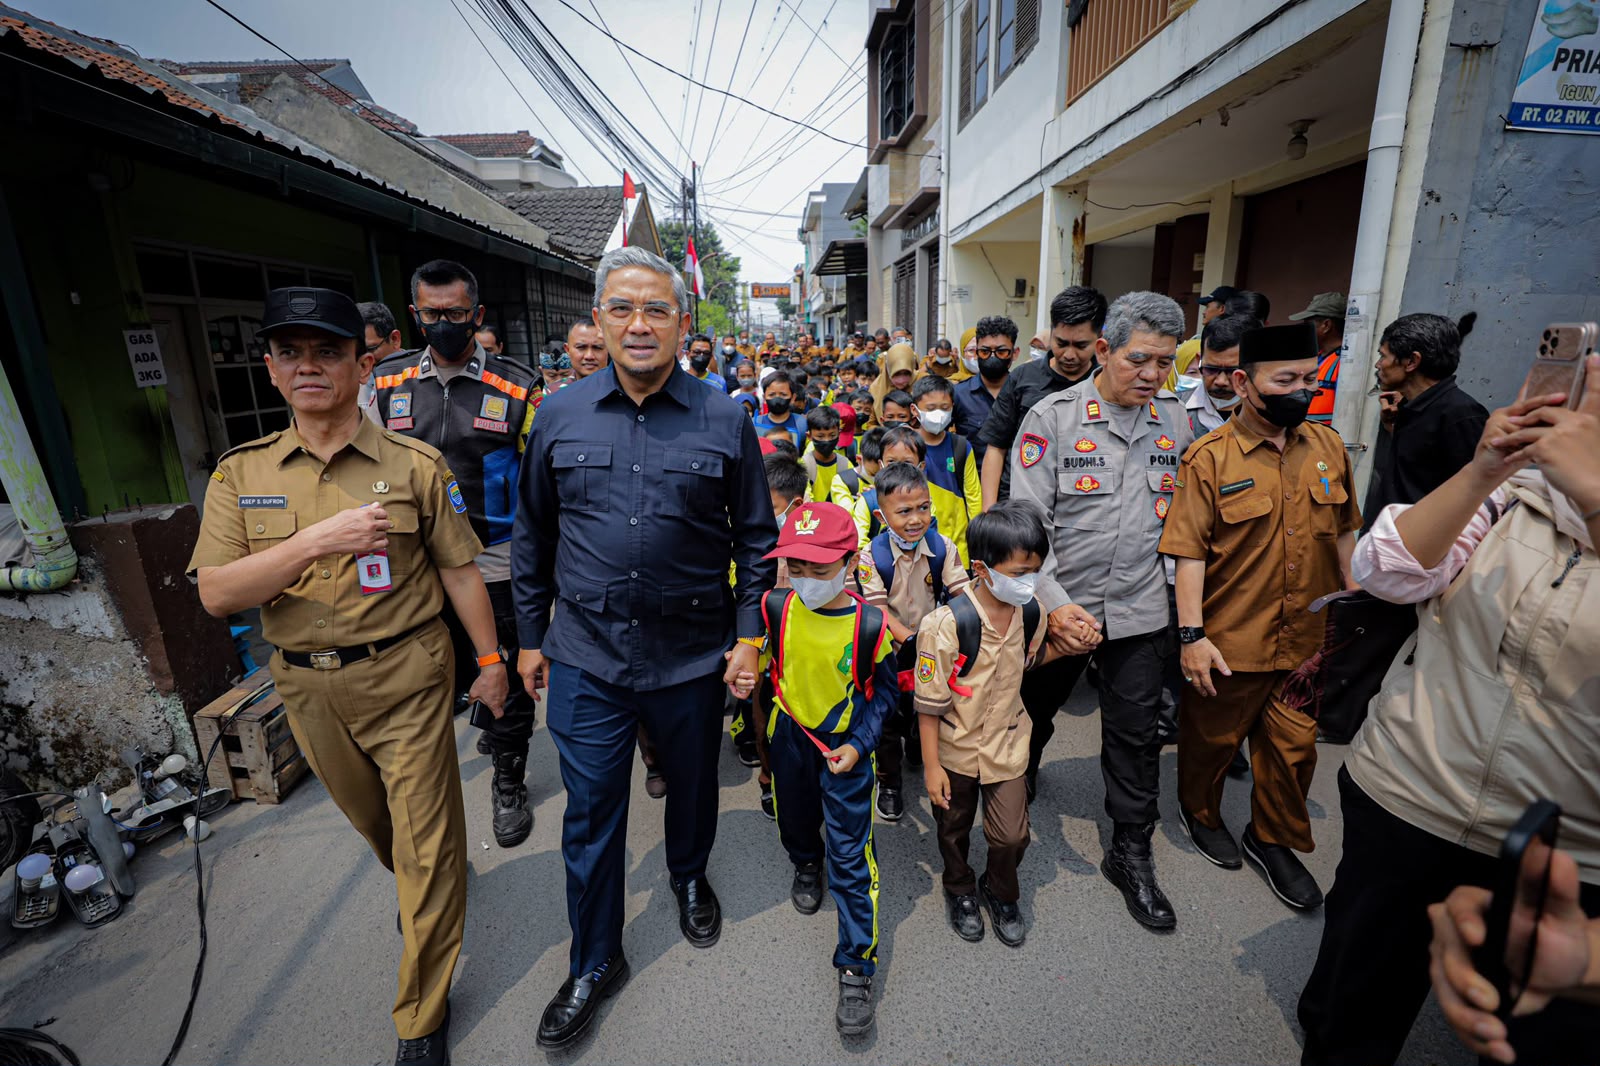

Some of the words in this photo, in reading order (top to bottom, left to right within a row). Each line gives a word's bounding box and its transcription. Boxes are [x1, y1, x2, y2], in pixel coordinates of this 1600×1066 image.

[1521, 107, 1541, 122] RT.
[1545, 108, 1562, 123] 02
[1565, 110, 1590, 125] RW.
[129, 334, 154, 345] GAS
[134, 352, 159, 363] ADA
[138, 370, 162, 381] 3KG
